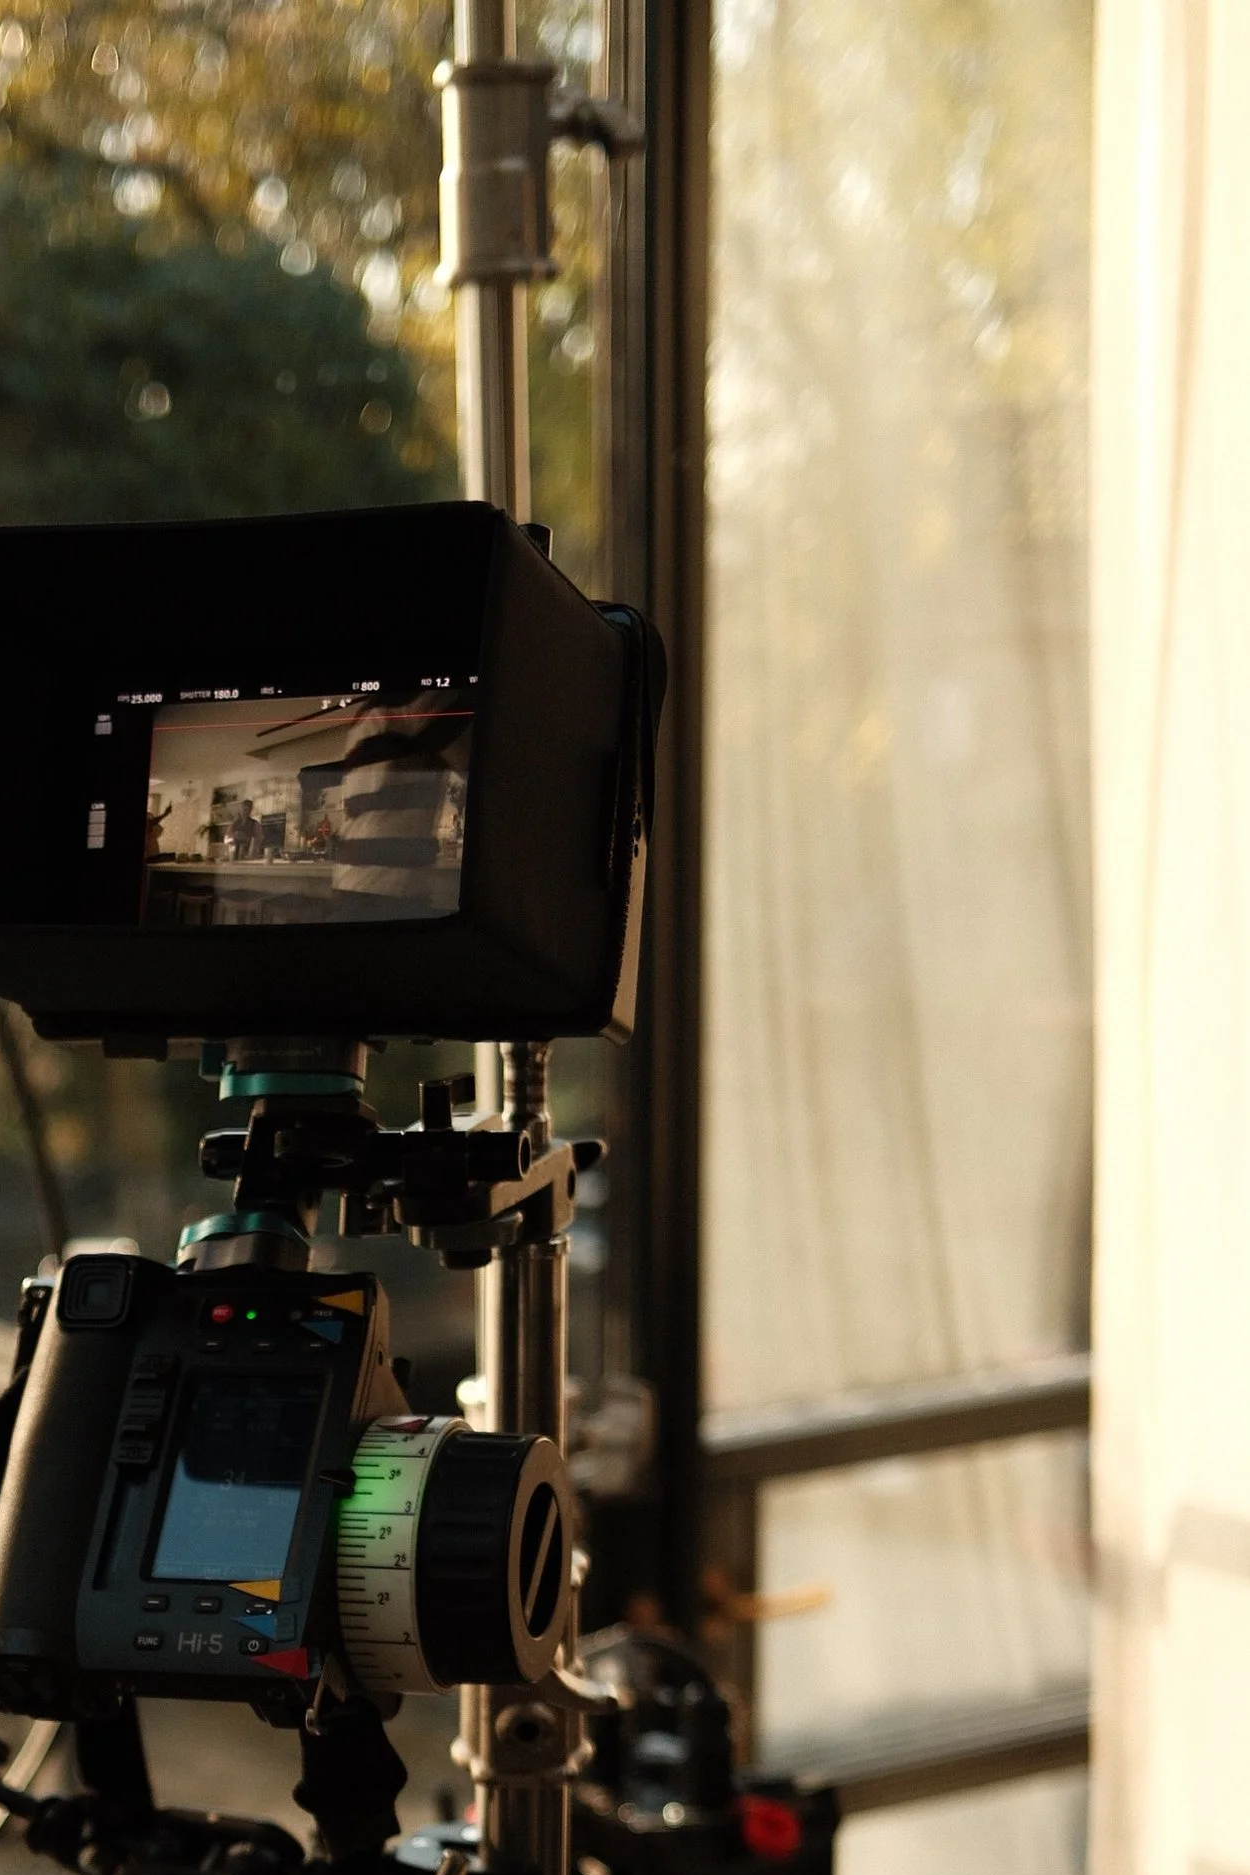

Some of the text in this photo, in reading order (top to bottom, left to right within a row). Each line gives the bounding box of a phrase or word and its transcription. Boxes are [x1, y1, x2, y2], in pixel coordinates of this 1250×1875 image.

[360, 681, 381, 692] 800
[435, 676, 451, 688] 1.2
[179, 688, 240, 701] SHUTTER 180.0
[136, 1636, 160, 1646] FUNC
[177, 1631, 225, 1655] Hi-5
